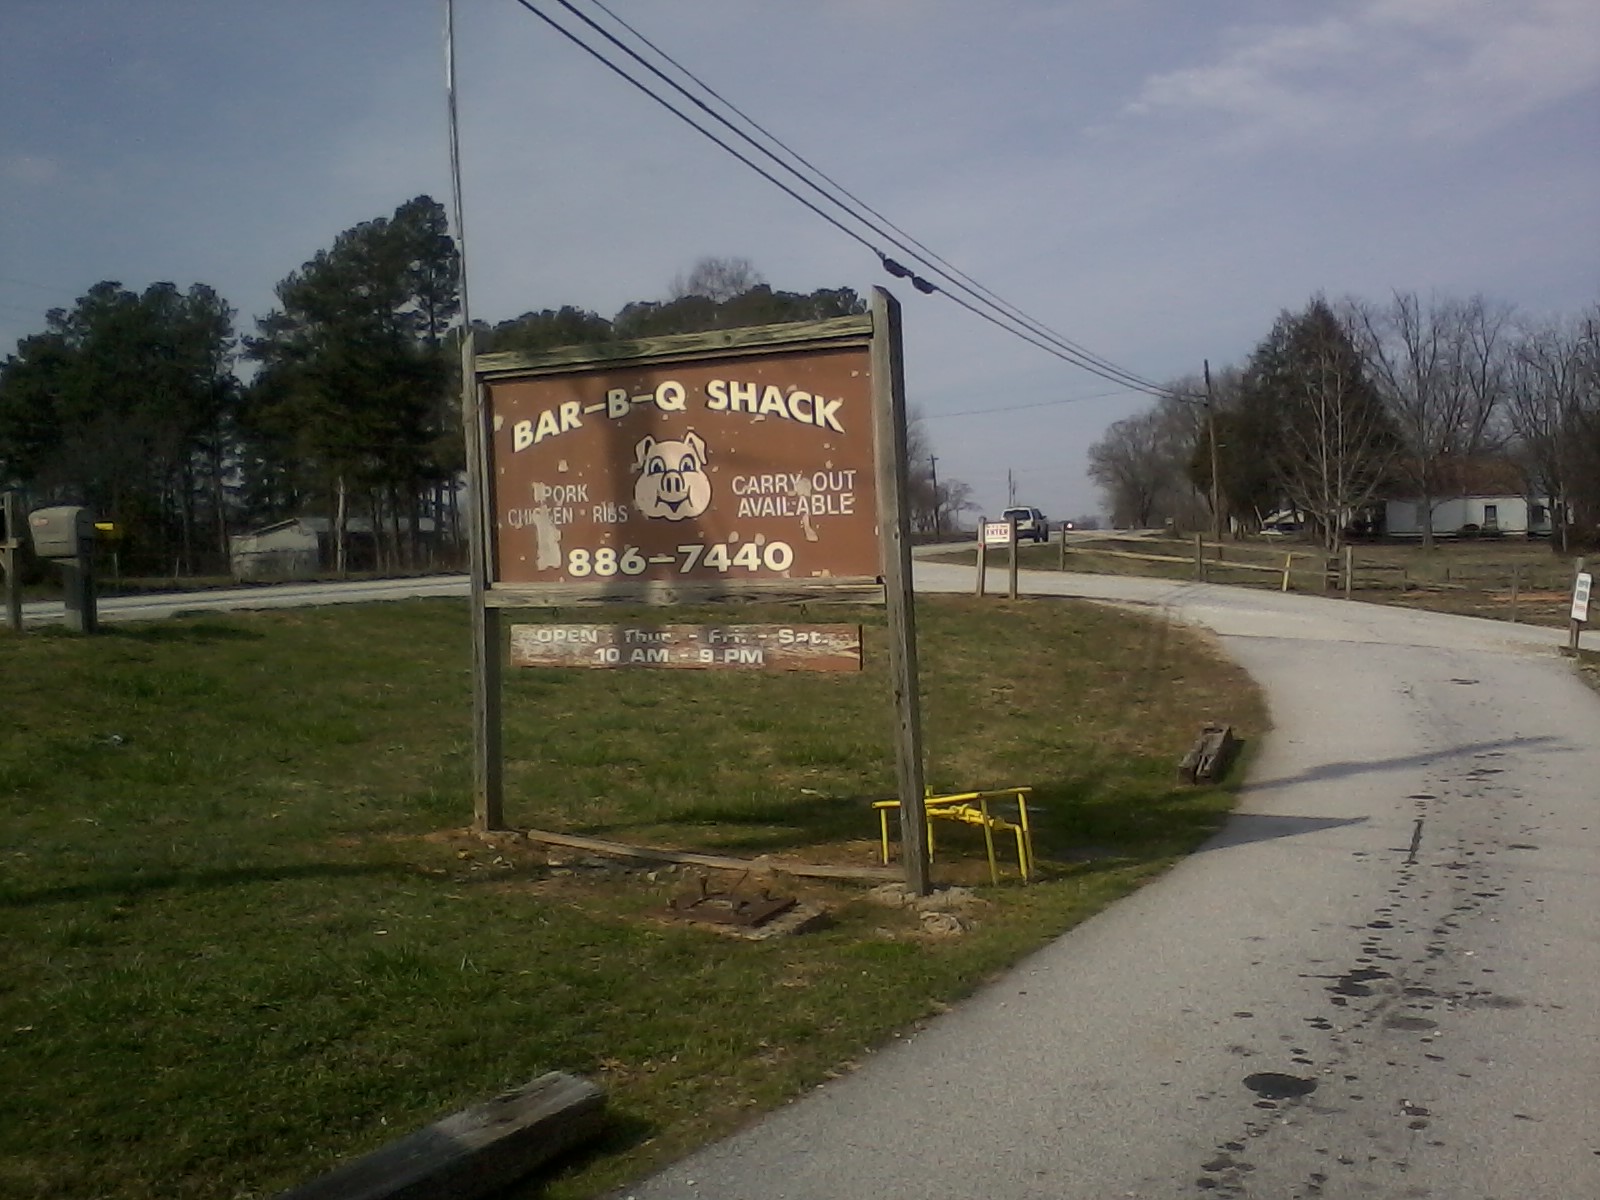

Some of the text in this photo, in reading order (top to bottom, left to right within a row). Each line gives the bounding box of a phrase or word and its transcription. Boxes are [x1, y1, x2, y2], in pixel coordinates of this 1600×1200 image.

[513, 379, 845, 453] BAR-B-Q SHACK
[543, 483, 589, 503] PORK
[731, 469, 857, 496] CARRY OUT
[507, 502, 629, 526] CHIEN RIBS
[737, 492, 855, 518] AVAILABLE
[567, 541, 794, 577] 886-7440
[536, 628, 599, 644] OPEN
[708, 628, 747, 644] Fri.
[778, 628, 829, 645] Sat.
[594, 647, 621, 663] 10
[630, 647, 670, 663] AM
[700, 648, 714, 663] 9
[724, 648, 765, 664] PM
